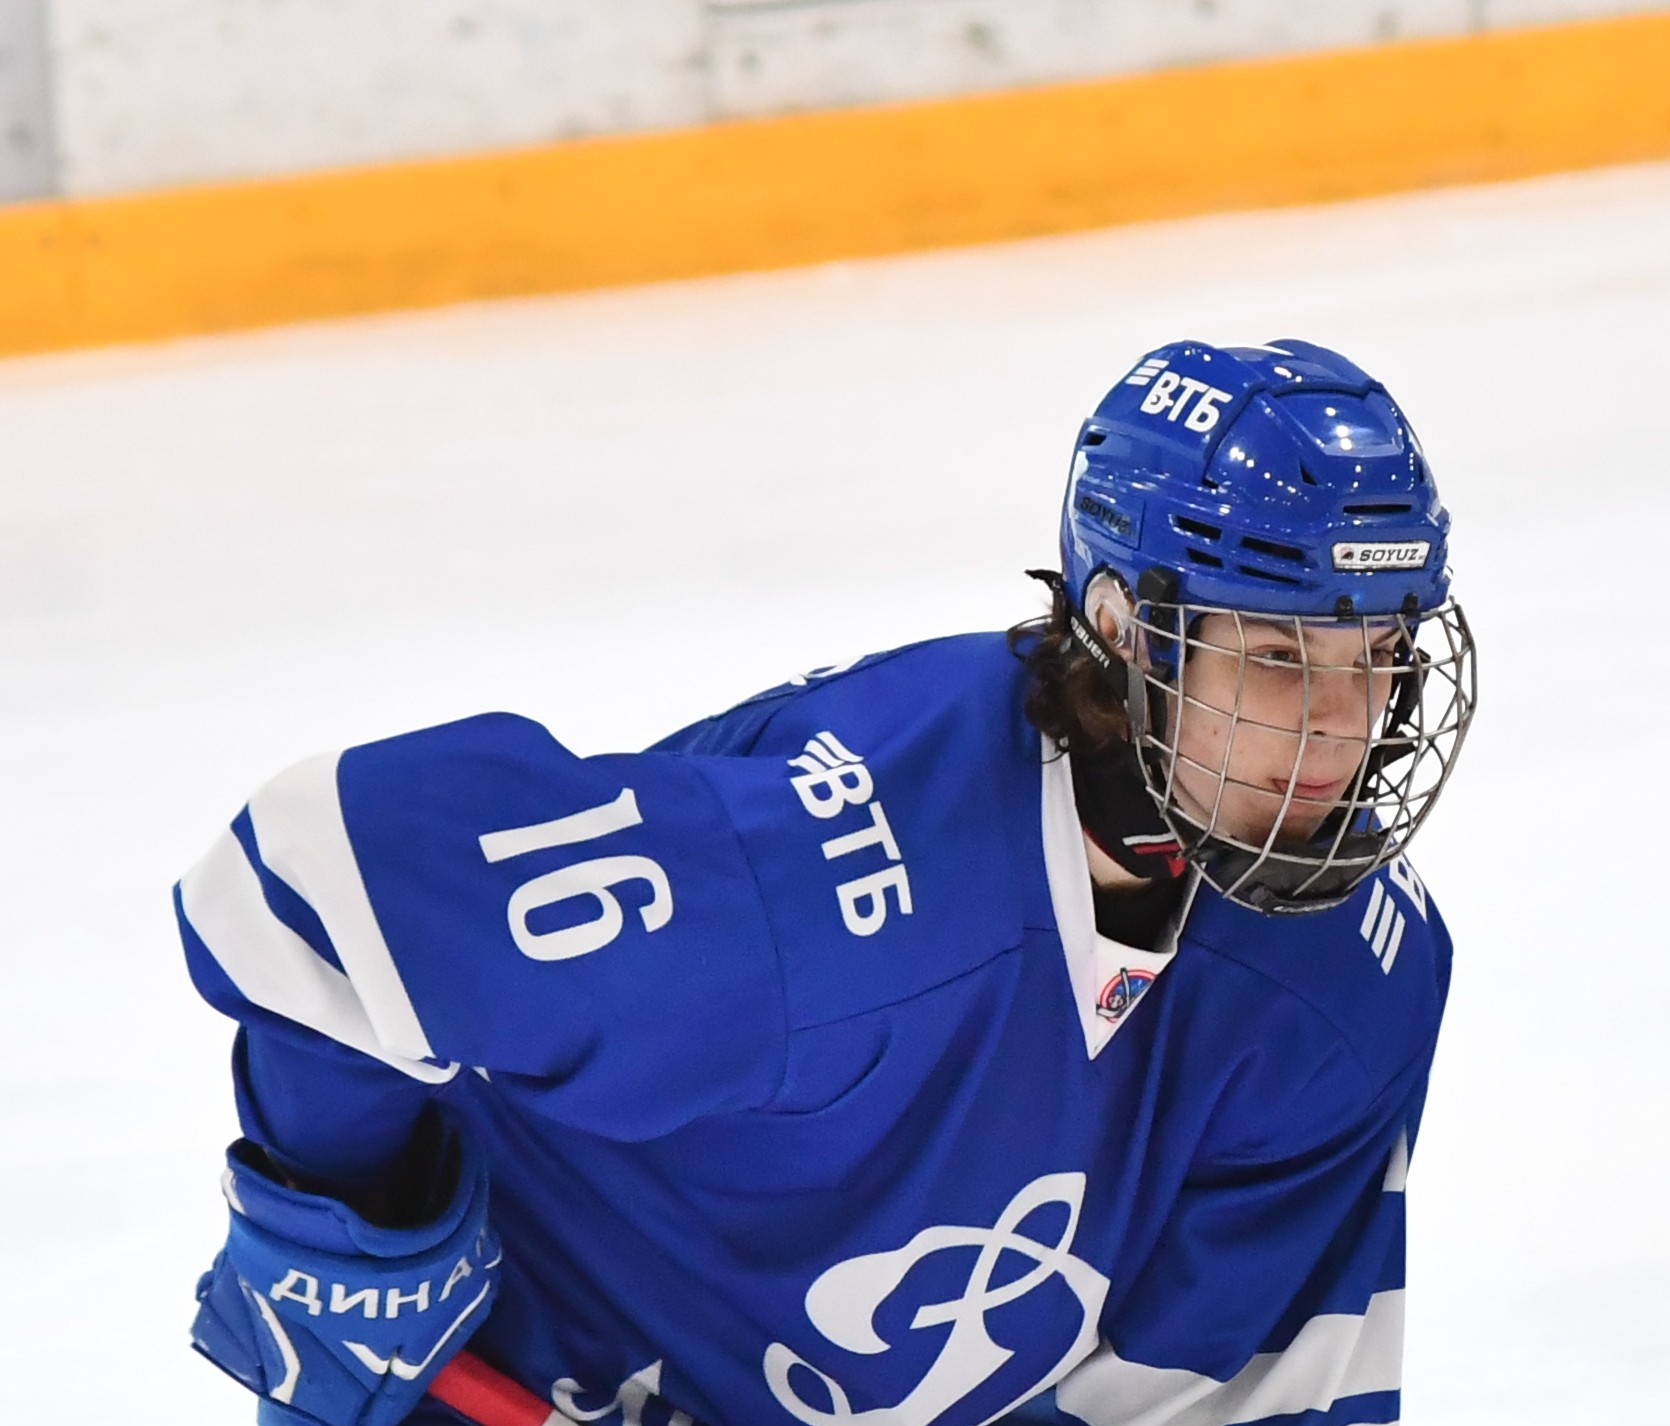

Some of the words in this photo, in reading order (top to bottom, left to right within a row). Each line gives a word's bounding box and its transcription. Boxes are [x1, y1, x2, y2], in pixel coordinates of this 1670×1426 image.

[1140, 370, 1233, 432] ВТБ
[478, 787, 674, 962] 16
[790, 758, 914, 937] ВТБ
